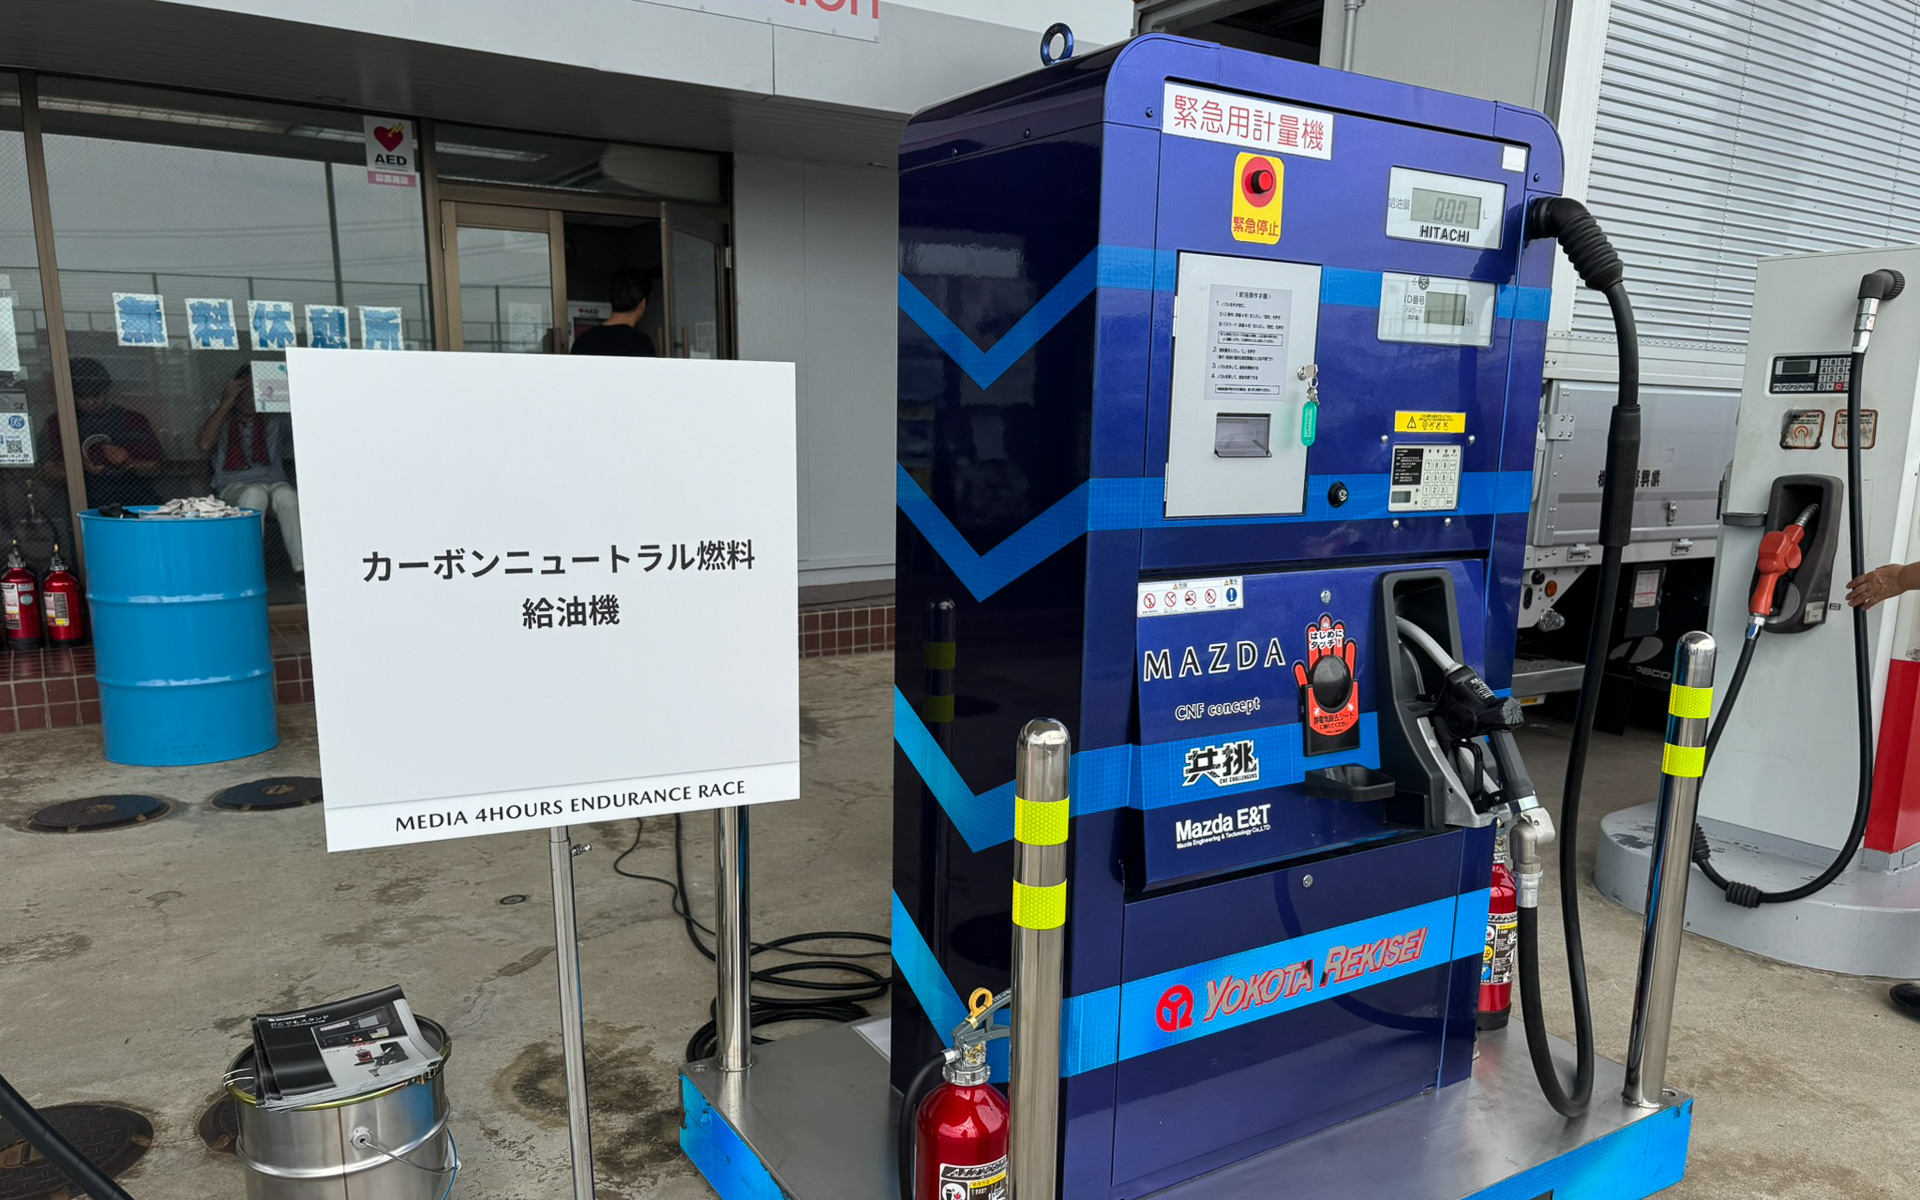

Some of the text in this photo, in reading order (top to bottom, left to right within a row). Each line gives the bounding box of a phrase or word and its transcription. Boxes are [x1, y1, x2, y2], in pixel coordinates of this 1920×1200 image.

[1174, 94, 1325, 151] 緊急用計量機
[375, 153, 407, 166] AED
[1233, 216, 1279, 237] 緊急停止
[1419, 225, 1470, 243] HITACHI
[362, 539, 755, 583] カーボンニュートラル燃料
[521, 594, 620, 630] 給油機
[1310, 630, 1344, 641] はじめに
[1143, 637, 1286, 682] MAZDA
[1175, 697, 1260, 721] CNF concept
[395, 780, 746, 832] MEDIA 4HOURS ENDURANCE RACE
[1175, 803, 1271, 843] Mazda E&T
[1176, 841, 1193, 850] Mazda
[1193, 835, 1221, 846] Engineering
[1226, 829, 1252, 839] Technology
[1203, 959, 1314, 1022] YOKOTA
[1319, 927, 1428, 987] REKISEI
